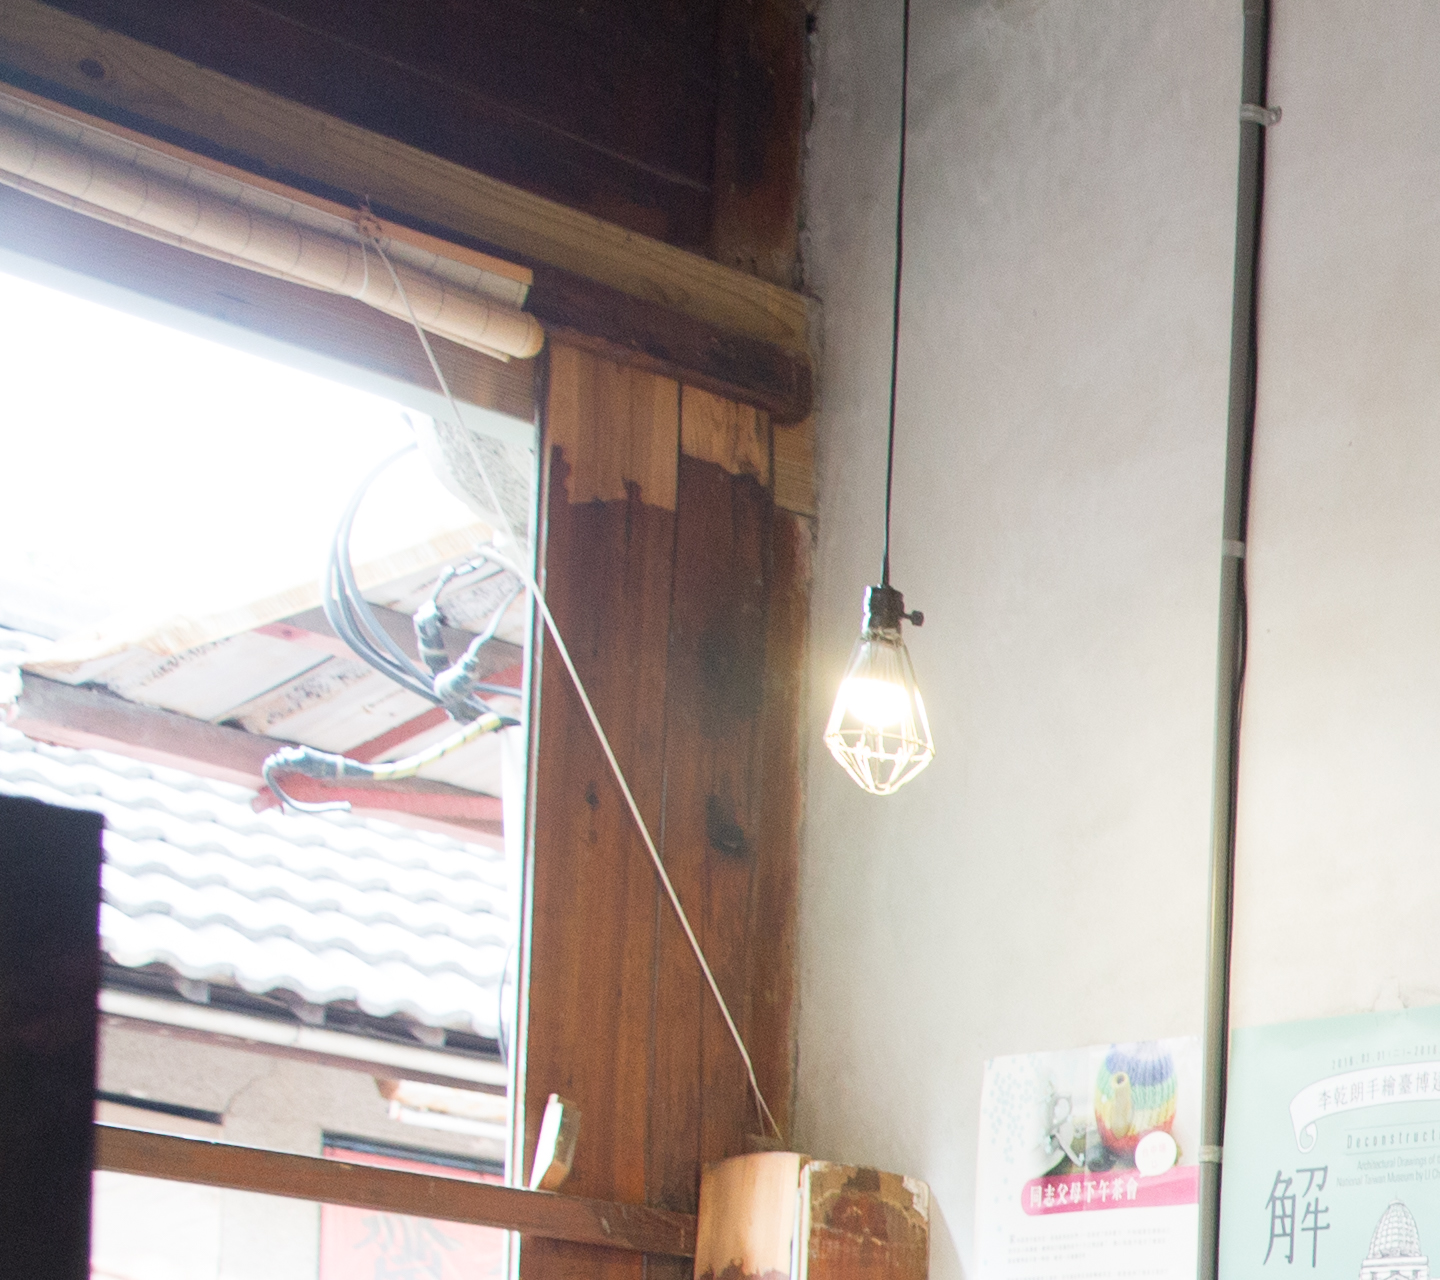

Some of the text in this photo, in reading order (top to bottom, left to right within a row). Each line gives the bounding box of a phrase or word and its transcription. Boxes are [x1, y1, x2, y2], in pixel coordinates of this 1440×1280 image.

[1029, 1177, 1139, 1209] 同志父母下午茶會
[1262, 1164, 1331, 1269] 解
